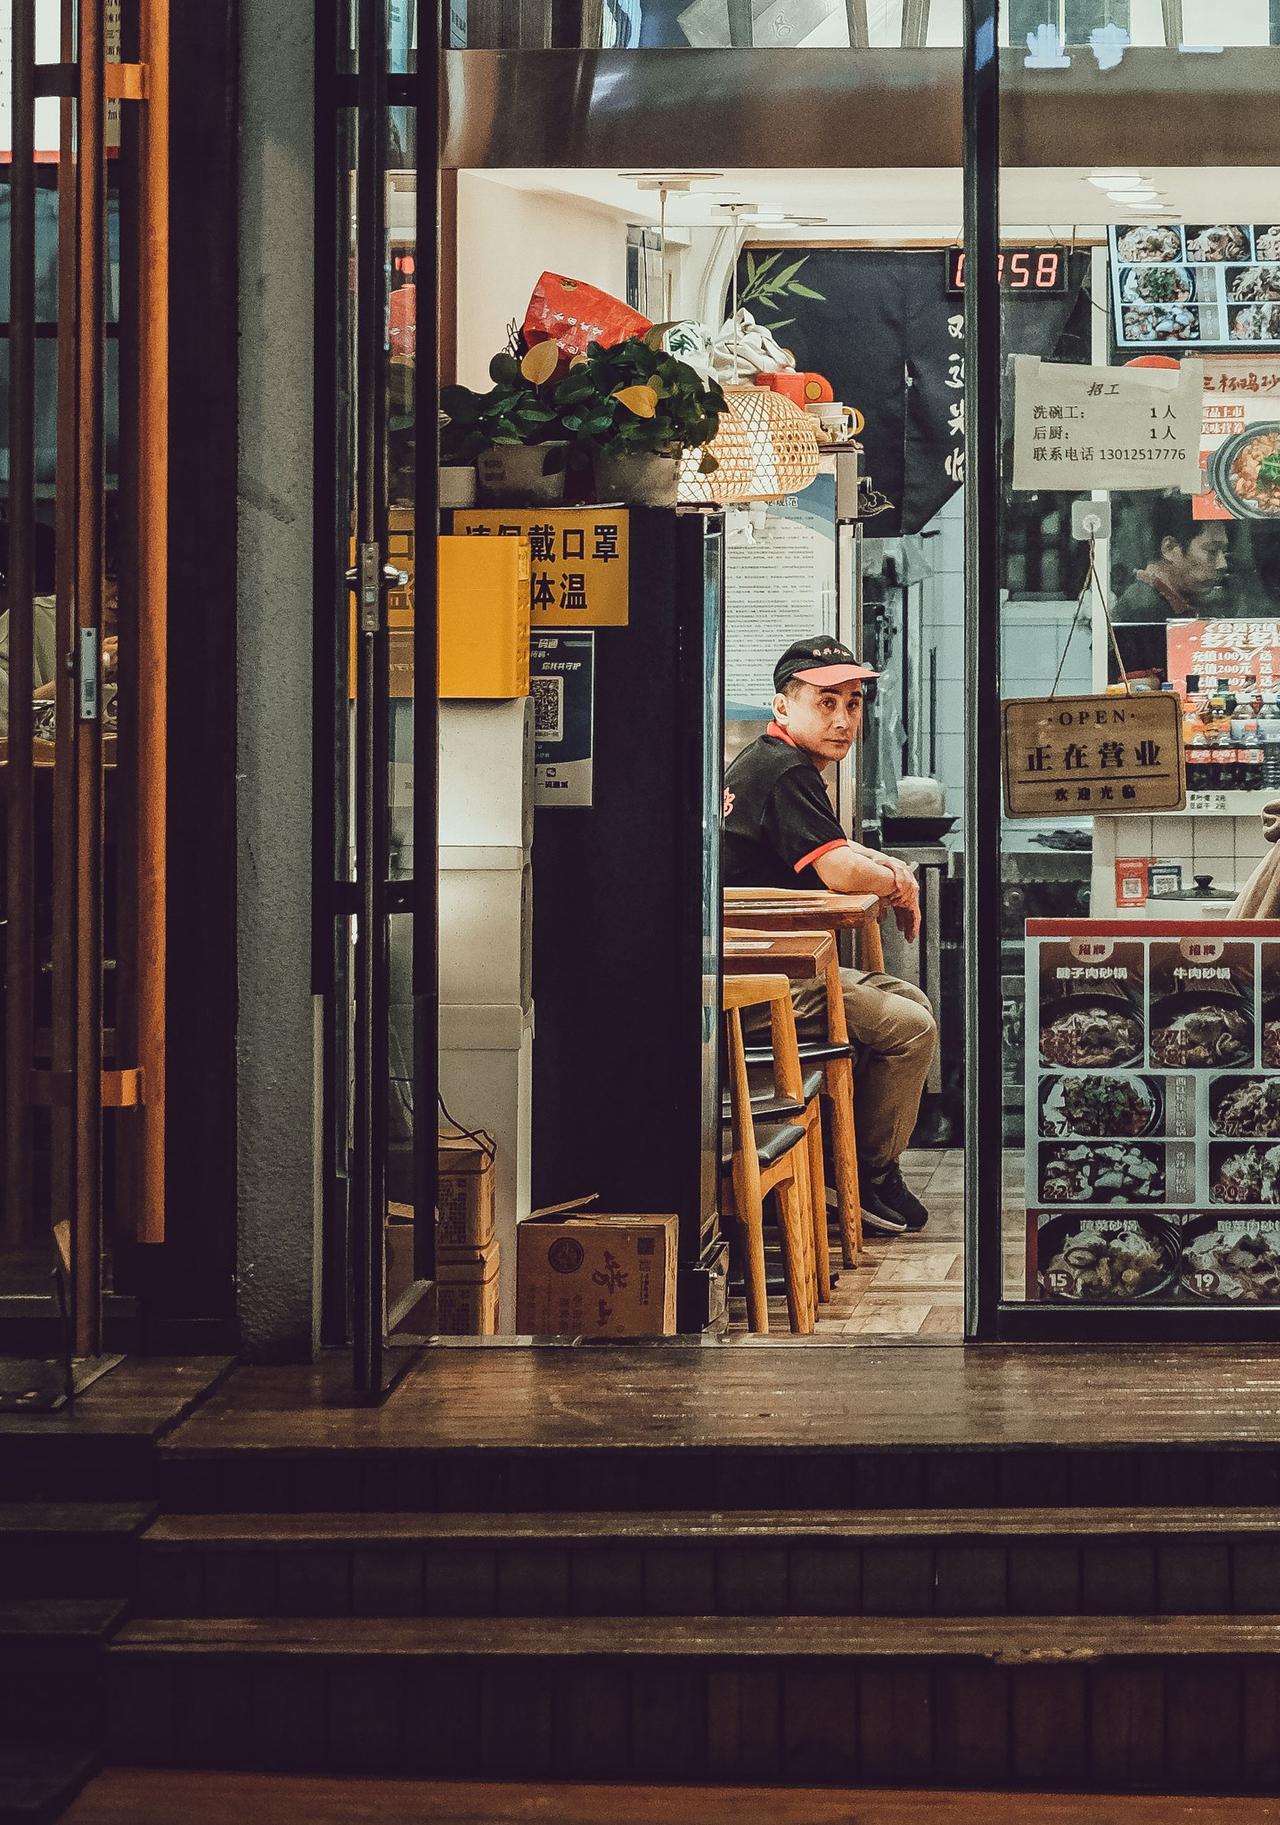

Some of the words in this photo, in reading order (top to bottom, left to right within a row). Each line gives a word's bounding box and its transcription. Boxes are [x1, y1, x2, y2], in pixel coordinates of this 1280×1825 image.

[1086, 381, 1121, 397] 招工
[1032, 446, 1095, 462] 联系电话
[1099, 447, 1186, 461] 13012517776
[1058, 709, 1126, 726] OPEN
[1024, 739, 1162, 772] 正在营业
[1053, 783, 1137, 802] 欢迎光临
[1188, 944, 1216, 956] 招牌
[1173, 966, 1231, 980] 牛肉砂锅
[1049, 1274, 1067, 1287] 15
[1194, 1274, 1213, 1288] 19
